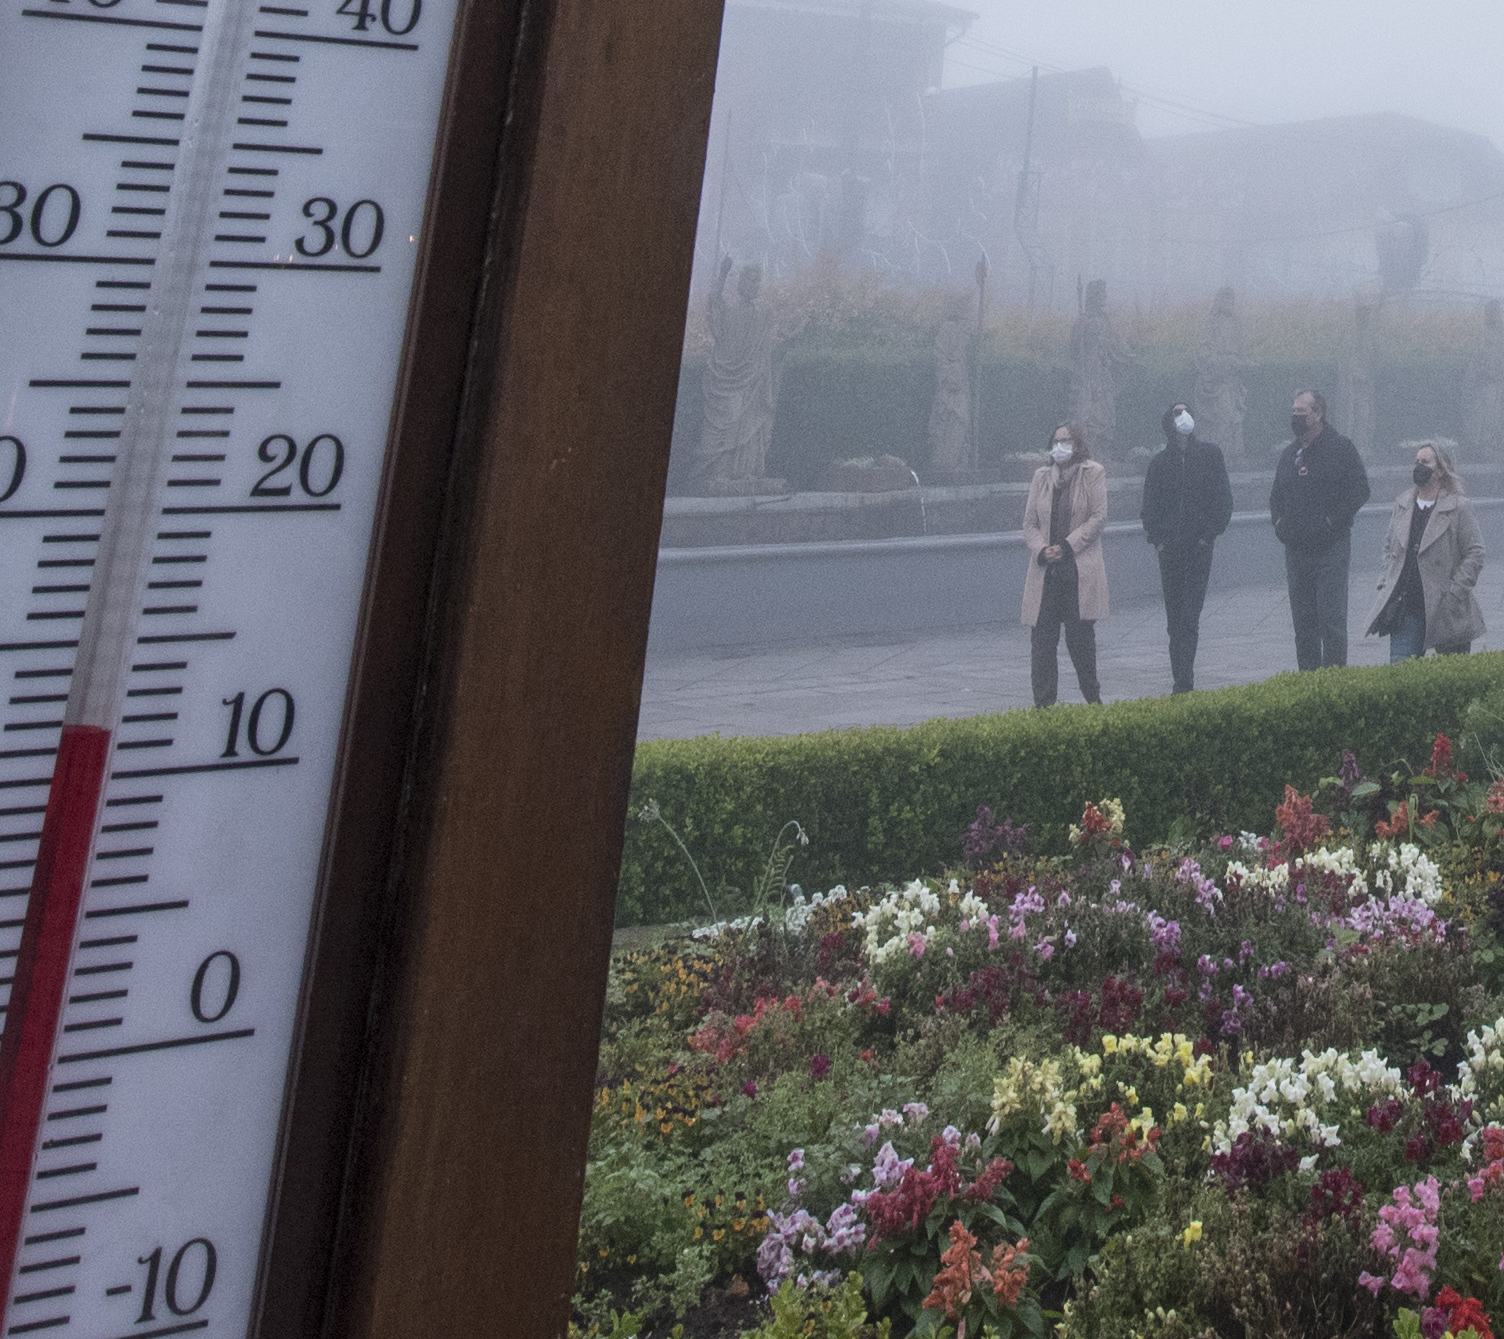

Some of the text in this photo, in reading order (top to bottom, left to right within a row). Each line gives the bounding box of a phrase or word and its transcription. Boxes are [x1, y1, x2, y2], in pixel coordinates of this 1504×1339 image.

[294, 197, 385, 258] 30
[251, 433, 344, 499] 20
[222, 687, 296, 758] 10
[190, 950, 242, 1024] 0
[105, 1237, 217, 1325] -10
